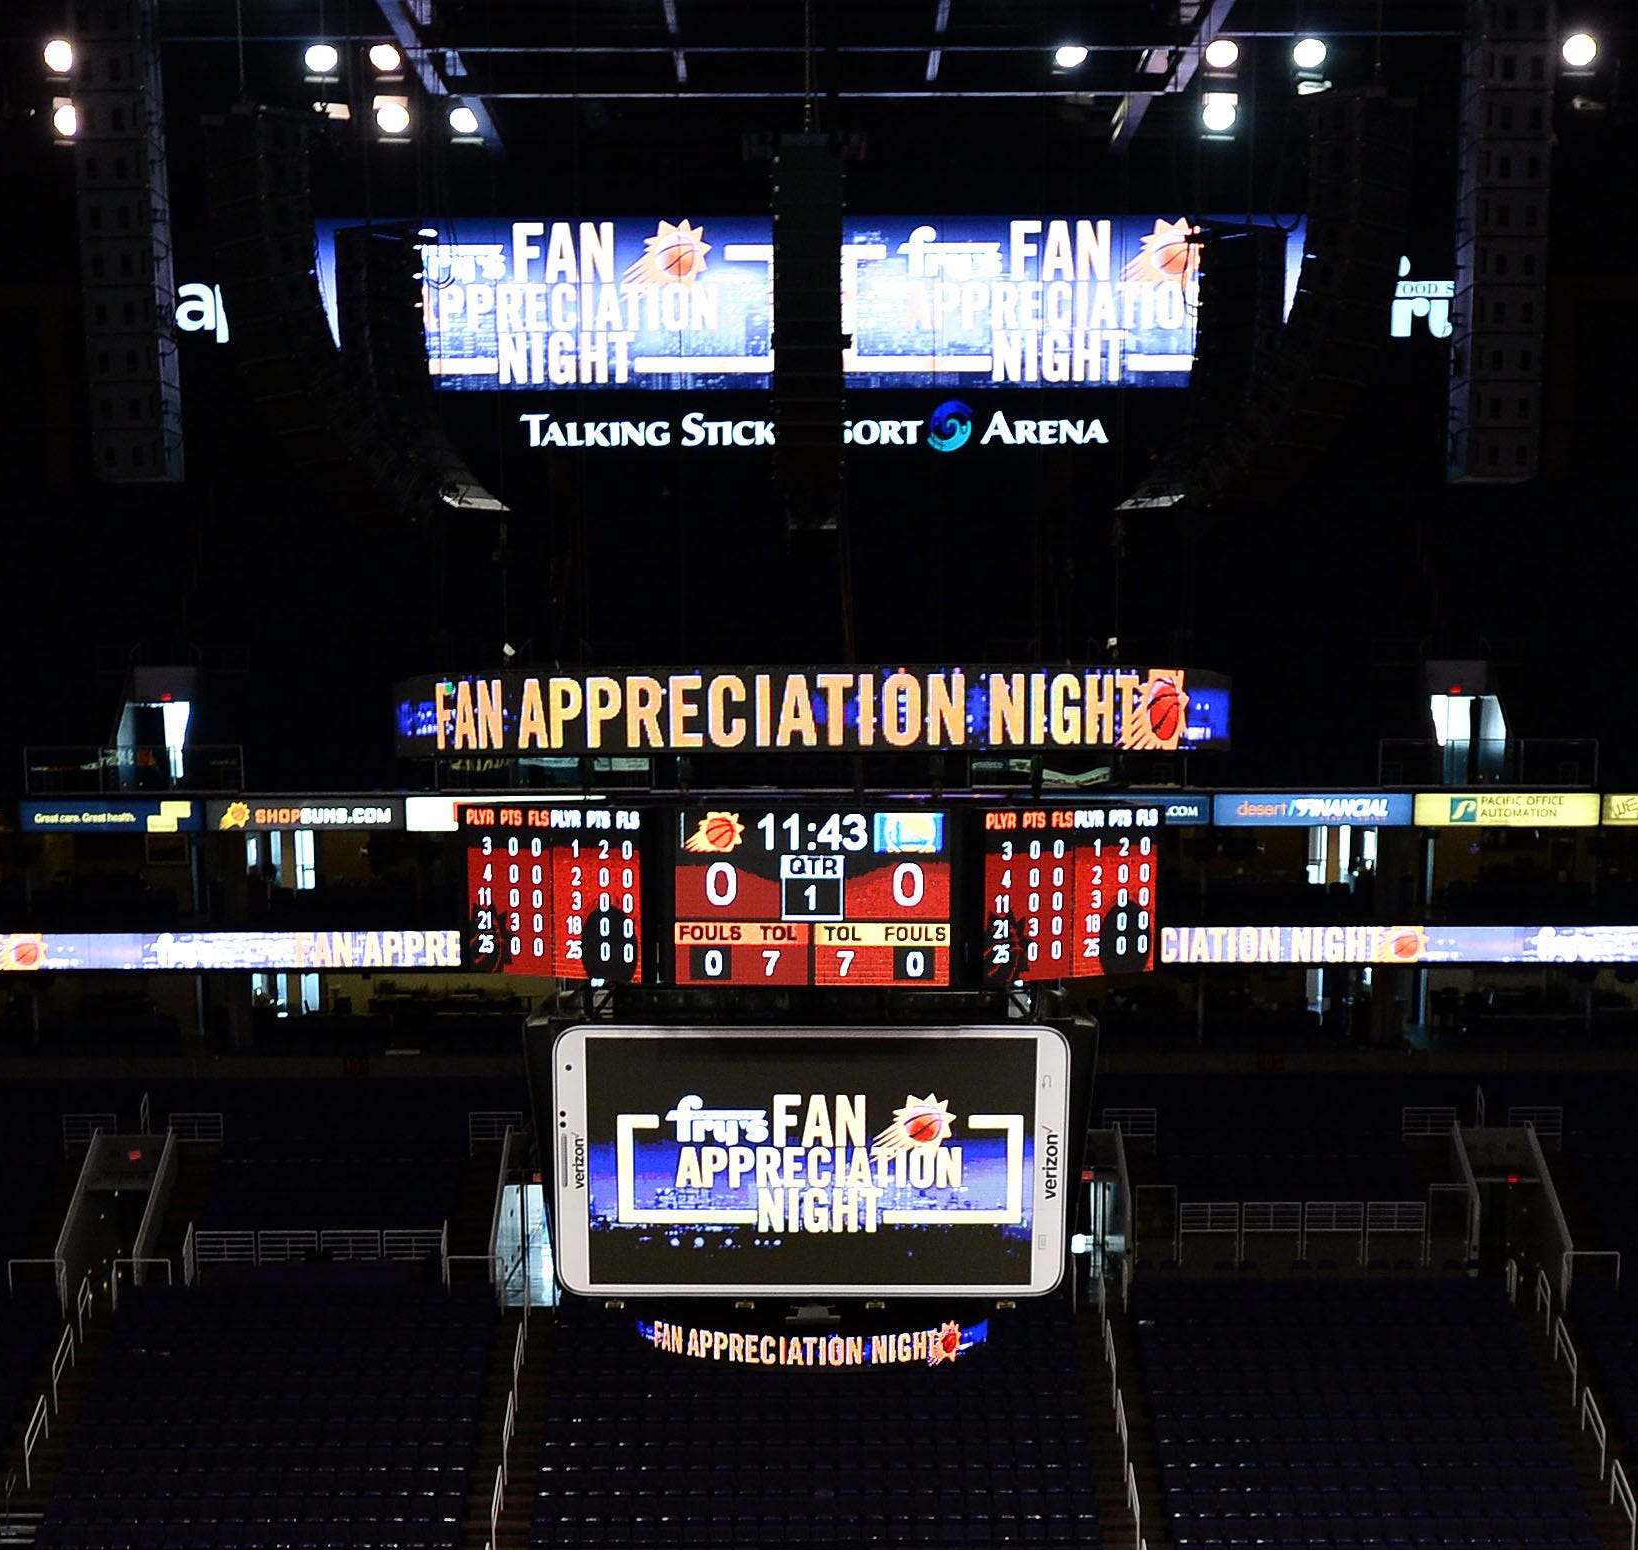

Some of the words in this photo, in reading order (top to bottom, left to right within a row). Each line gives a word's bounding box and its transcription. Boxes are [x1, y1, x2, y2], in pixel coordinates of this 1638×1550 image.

[512, 222, 614, 284] FAN
[1010, 221, 1111, 282] FAN
[906, 280, 1187, 332] APPRECIATIO
[498, 332, 636, 385] NIGHT
[992, 330, 1128, 382] NIGHT
[520, 413, 671, 447] TALKING
[681, 412, 775, 447] STICK
[844, 417, 923, 446] SORT
[981, 413, 1109, 445] ARENA
[436, 680, 502, 749] FAN
[519, 672, 964, 749] APPRECIATION
[989, 674, 1137, 746] NIGHT
[34, 813, 60, 824] Great
[60, 814, 81, 824] care.
[82, 813, 107, 824] Great
[107, 813, 137, 823] health.
[255, 807, 392, 825] SHOPSUNS.COM
[466, 808, 495, 826] PLYR
[500, 808, 523, 826] PTS
[528, 809, 550, 828] FLS
[586, 810, 611, 829] PTS
[615, 810, 640, 830] FLS
[1236, 801, 1288, 817] desert
[1297, 798, 1389, 818] FINANCIAL
[1480, 796, 1522, 807] PACIFIC
[1525, 795, 1564, 806] OFFICE
[1480, 808, 1558, 818] AUTOMATION
[482, 836, 492, 855] 3
[508, 837, 518, 856] 0
[531, 838, 541, 857] 0
[571, 839, 579, 858] 1
[598, 840, 609, 859] 2
[622, 840, 632, 860] 0
[757, 813, 868, 851] 11:43
[483, 864, 492, 882] 4
[508, 864, 519, 884] 0
[531, 865, 542, 884] 0
[571, 866, 582, 886] 2
[599, 867, 609, 887] 0
[622, 868, 633, 888] 0
[705, 861, 737, 907] 0
[790, 858, 837, 875] QTR
[892, 862, 924, 907] 0
[803, 885, 817, 911] 1
[295, 931, 353, 968] FAN
[679, 926, 741, 942] FOULS
[760, 926, 797, 942] TOL
[824, 926, 861, 942] TOL
[884, 926, 946, 942] FOULS
[1291, 927, 1379, 962] NIGHT
[704, 950, 723, 976] 0
[762, 950, 781, 976] 7
[836, 950, 855, 976] 7
[906, 951, 924, 976] 0
[666, 1094, 770, 1144] fry's
[773, 1095, 867, 1147] FAN
[575, 1137, 584, 1190] verizon
[675, 1146, 963, 1190] APPRECIATION
[1045, 1133, 1058, 1200] verizon
[756, 1187, 881, 1235] NIGHT
[654, 1322, 684, 1356] FAN
[687, 1327, 863, 1367] APPRECIATION
[872, 1329, 936, 1365] NIGHT
